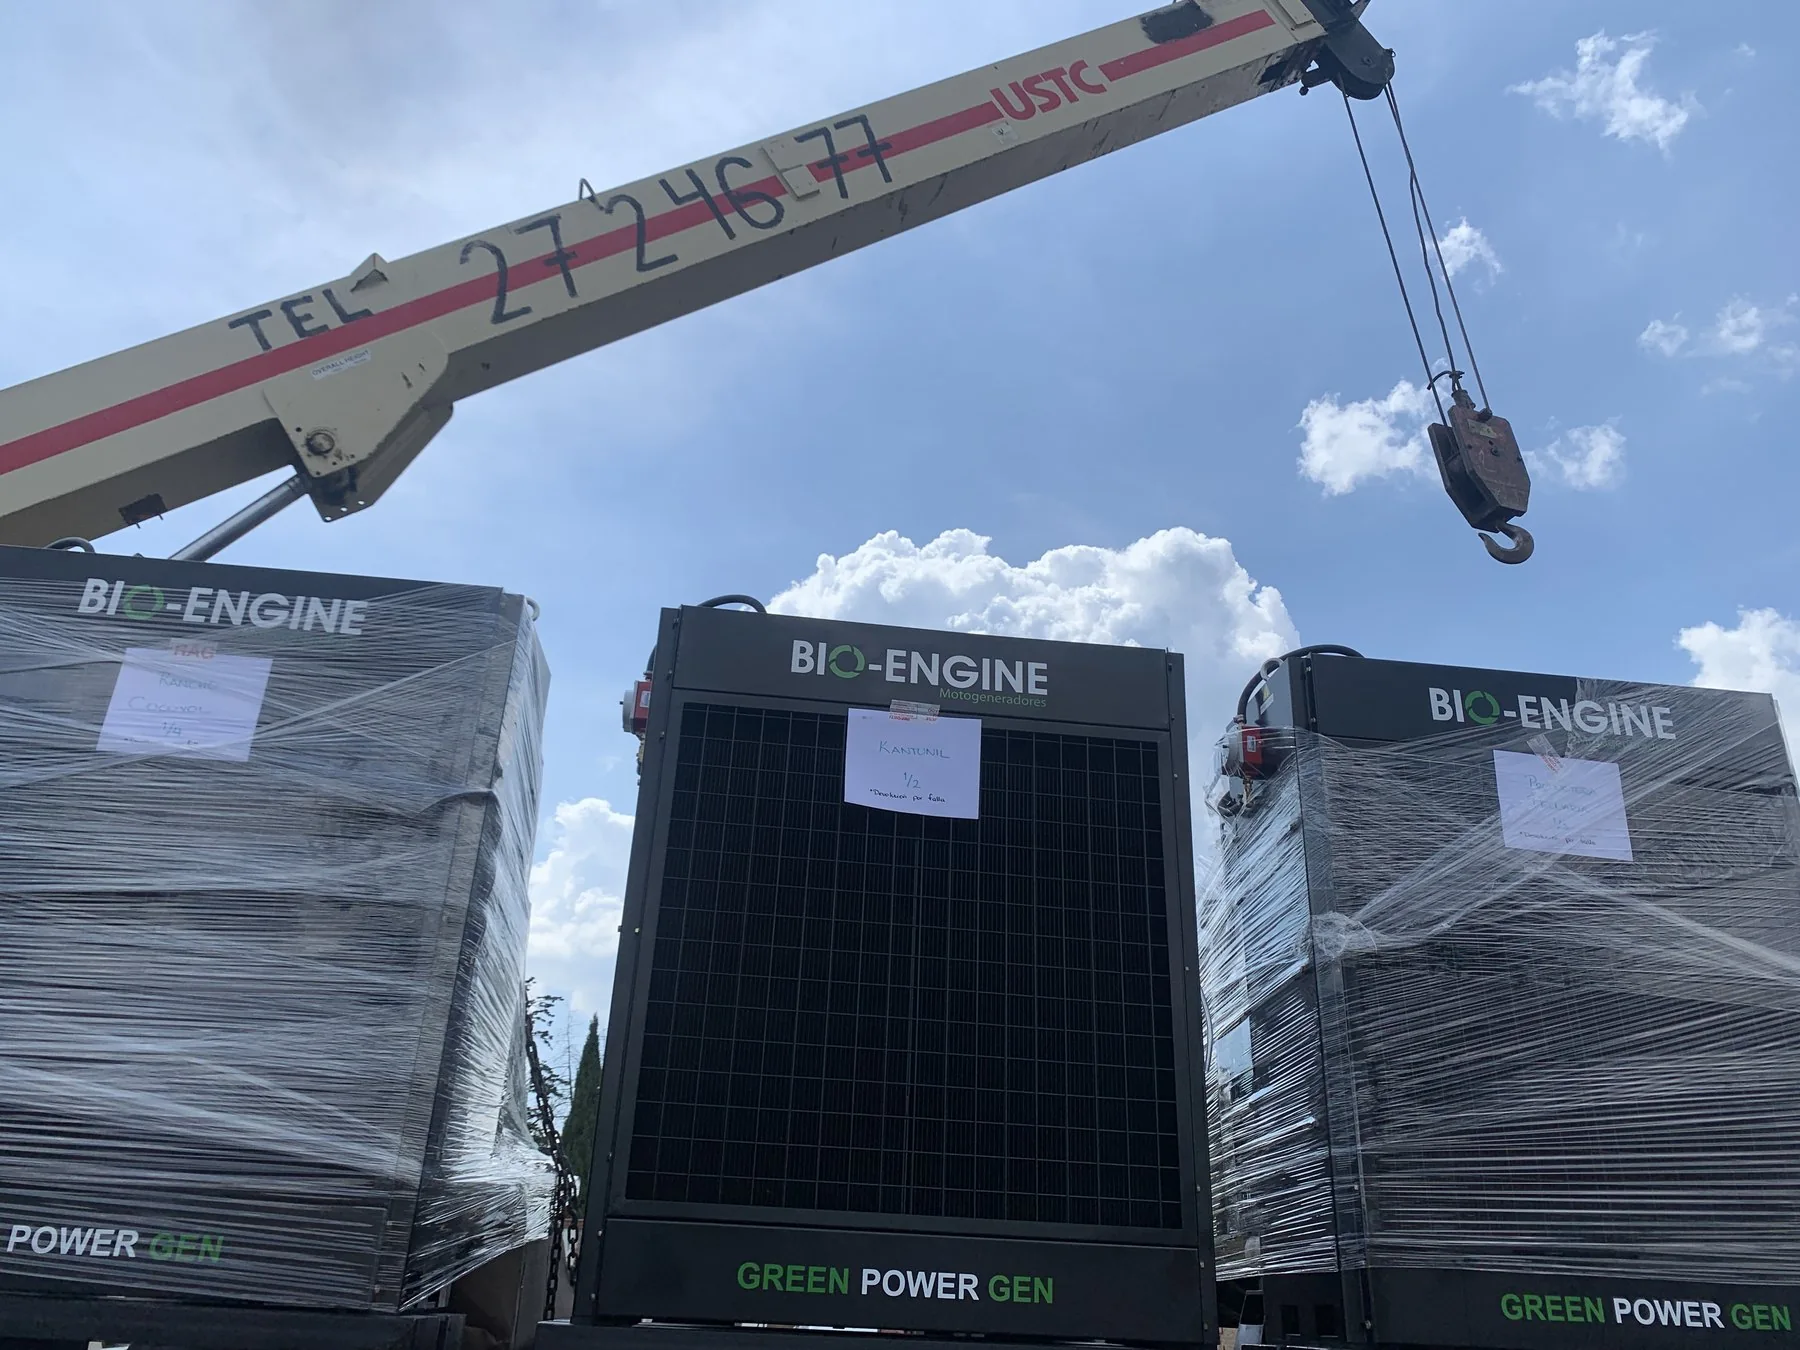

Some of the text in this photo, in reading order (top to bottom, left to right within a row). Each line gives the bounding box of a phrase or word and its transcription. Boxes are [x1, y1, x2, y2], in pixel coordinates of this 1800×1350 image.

[989, 60, 1107, 121] USTC
[229, 288, 374, 351] TEL
[312, 361, 344, 376] OVERALL
[344, 349, 369, 362] HEIGHT
[77, 577, 369, 636] BIO-ENGINE
[790, 639, 1048, 696] BIO-ENGINE
[939, 687, 1047, 708] Motogeneradores
[1429, 687, 1676, 740] BIO-ENGINE
[879, 740, 951, 759] KANTUNIL
[904, 772, 921, 788] 1/2
[6, 1224, 224, 1264] POWER GEN
[737, 1262, 1053, 1304] GREEN POWER GEN
[1501, 1293, 1792, 1331] GREEN POWER GEN
